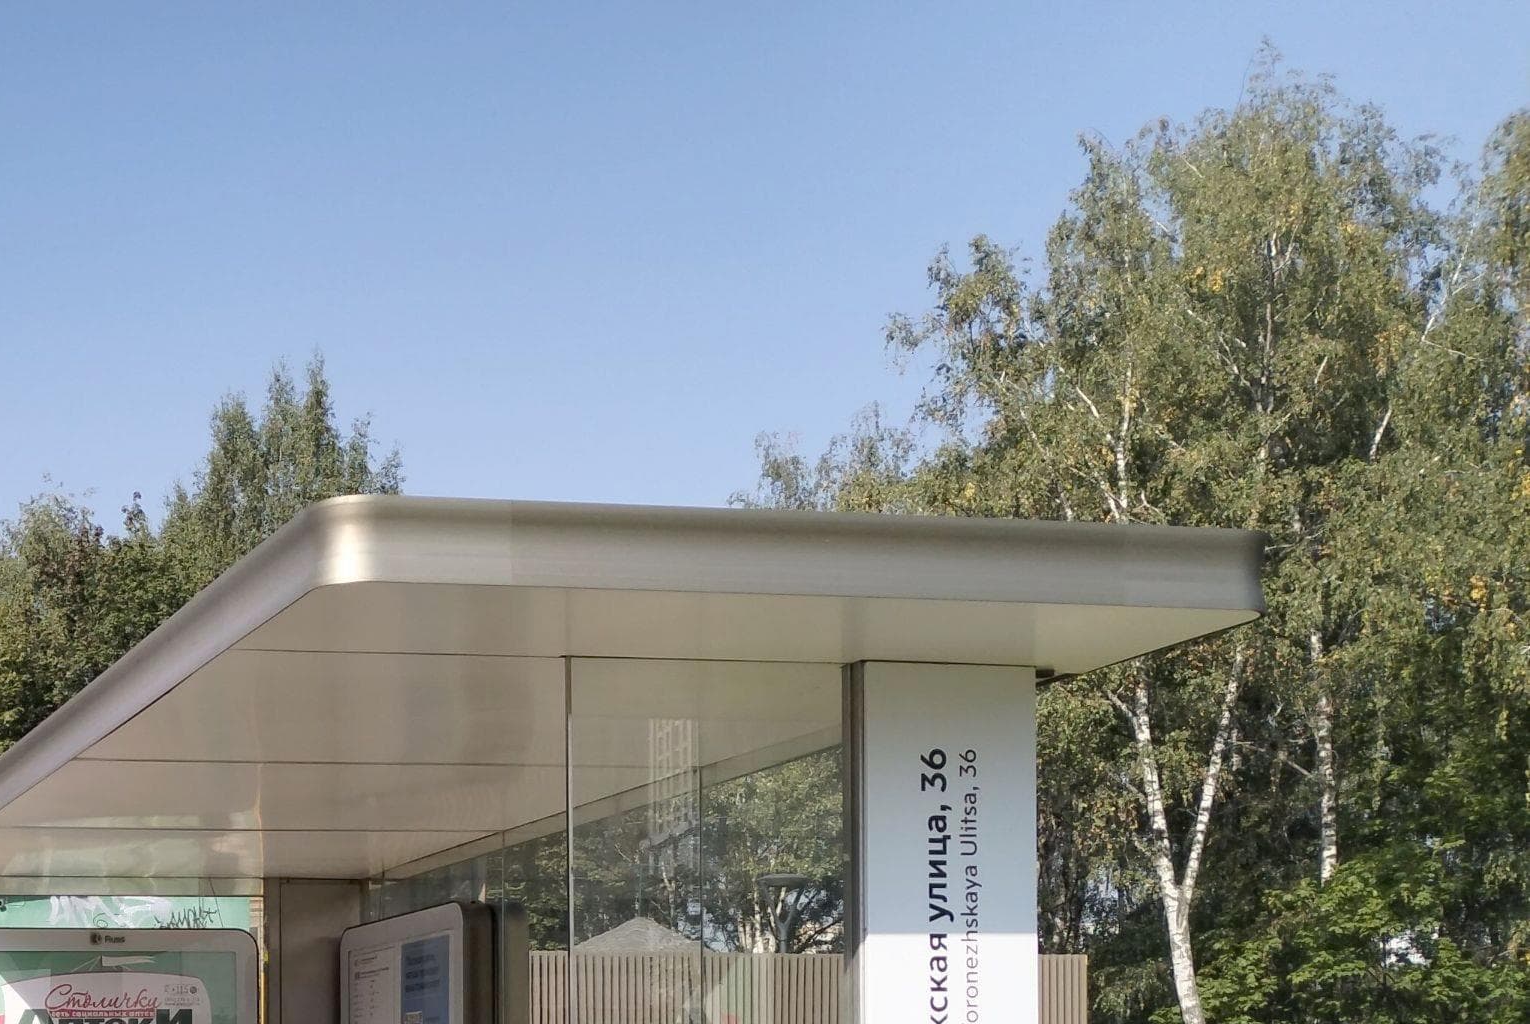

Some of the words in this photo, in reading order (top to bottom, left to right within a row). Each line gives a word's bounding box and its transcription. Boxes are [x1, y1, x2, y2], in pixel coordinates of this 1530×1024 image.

[920, 748, 948, 792] 36
[958, 749, 977, 778] 36
[959, 786, 981, 856] Ulitsa,
[928, 804, 954, 922] улица,
[44, 983, 160, 1010] Столички
